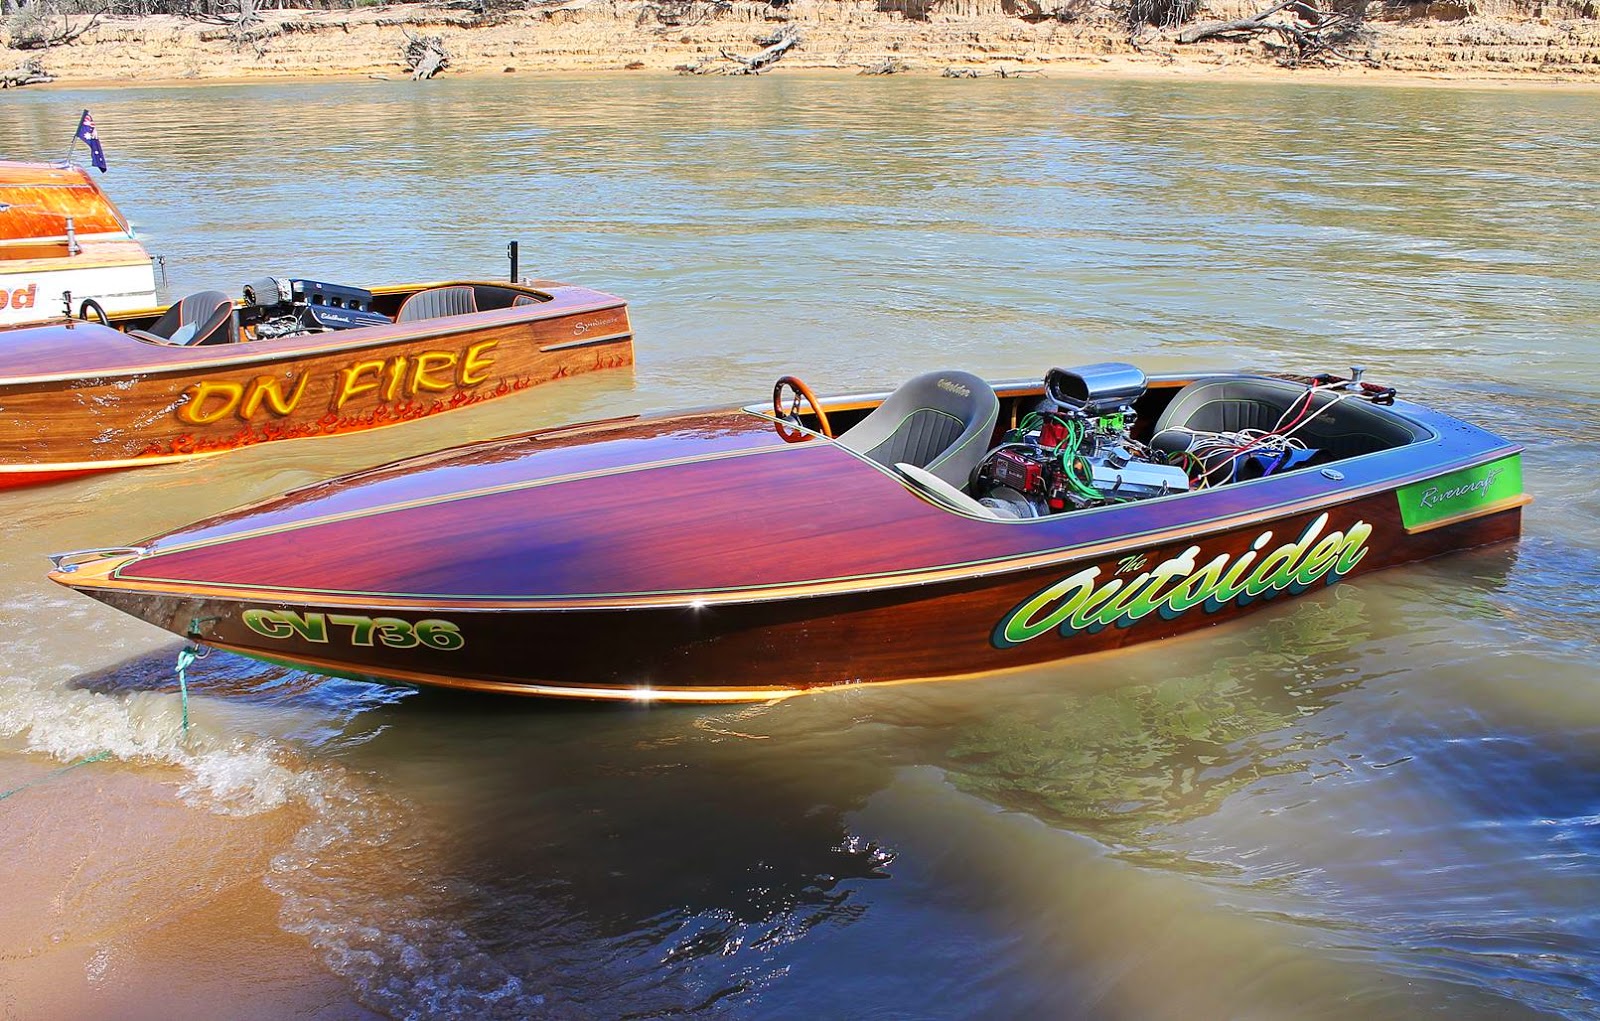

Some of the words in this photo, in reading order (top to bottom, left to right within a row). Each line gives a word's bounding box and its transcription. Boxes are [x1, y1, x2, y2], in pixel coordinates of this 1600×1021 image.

[184, 366, 310, 425] ON
[332, 339, 501, 413] FIRE
[1420, 467, 1504, 508] Rivercraft
[992, 511, 1373, 647] Outsider
[1114, 553, 1148, 576] The
[241, 608, 329, 644] CV
[327, 613, 465, 651] 736
